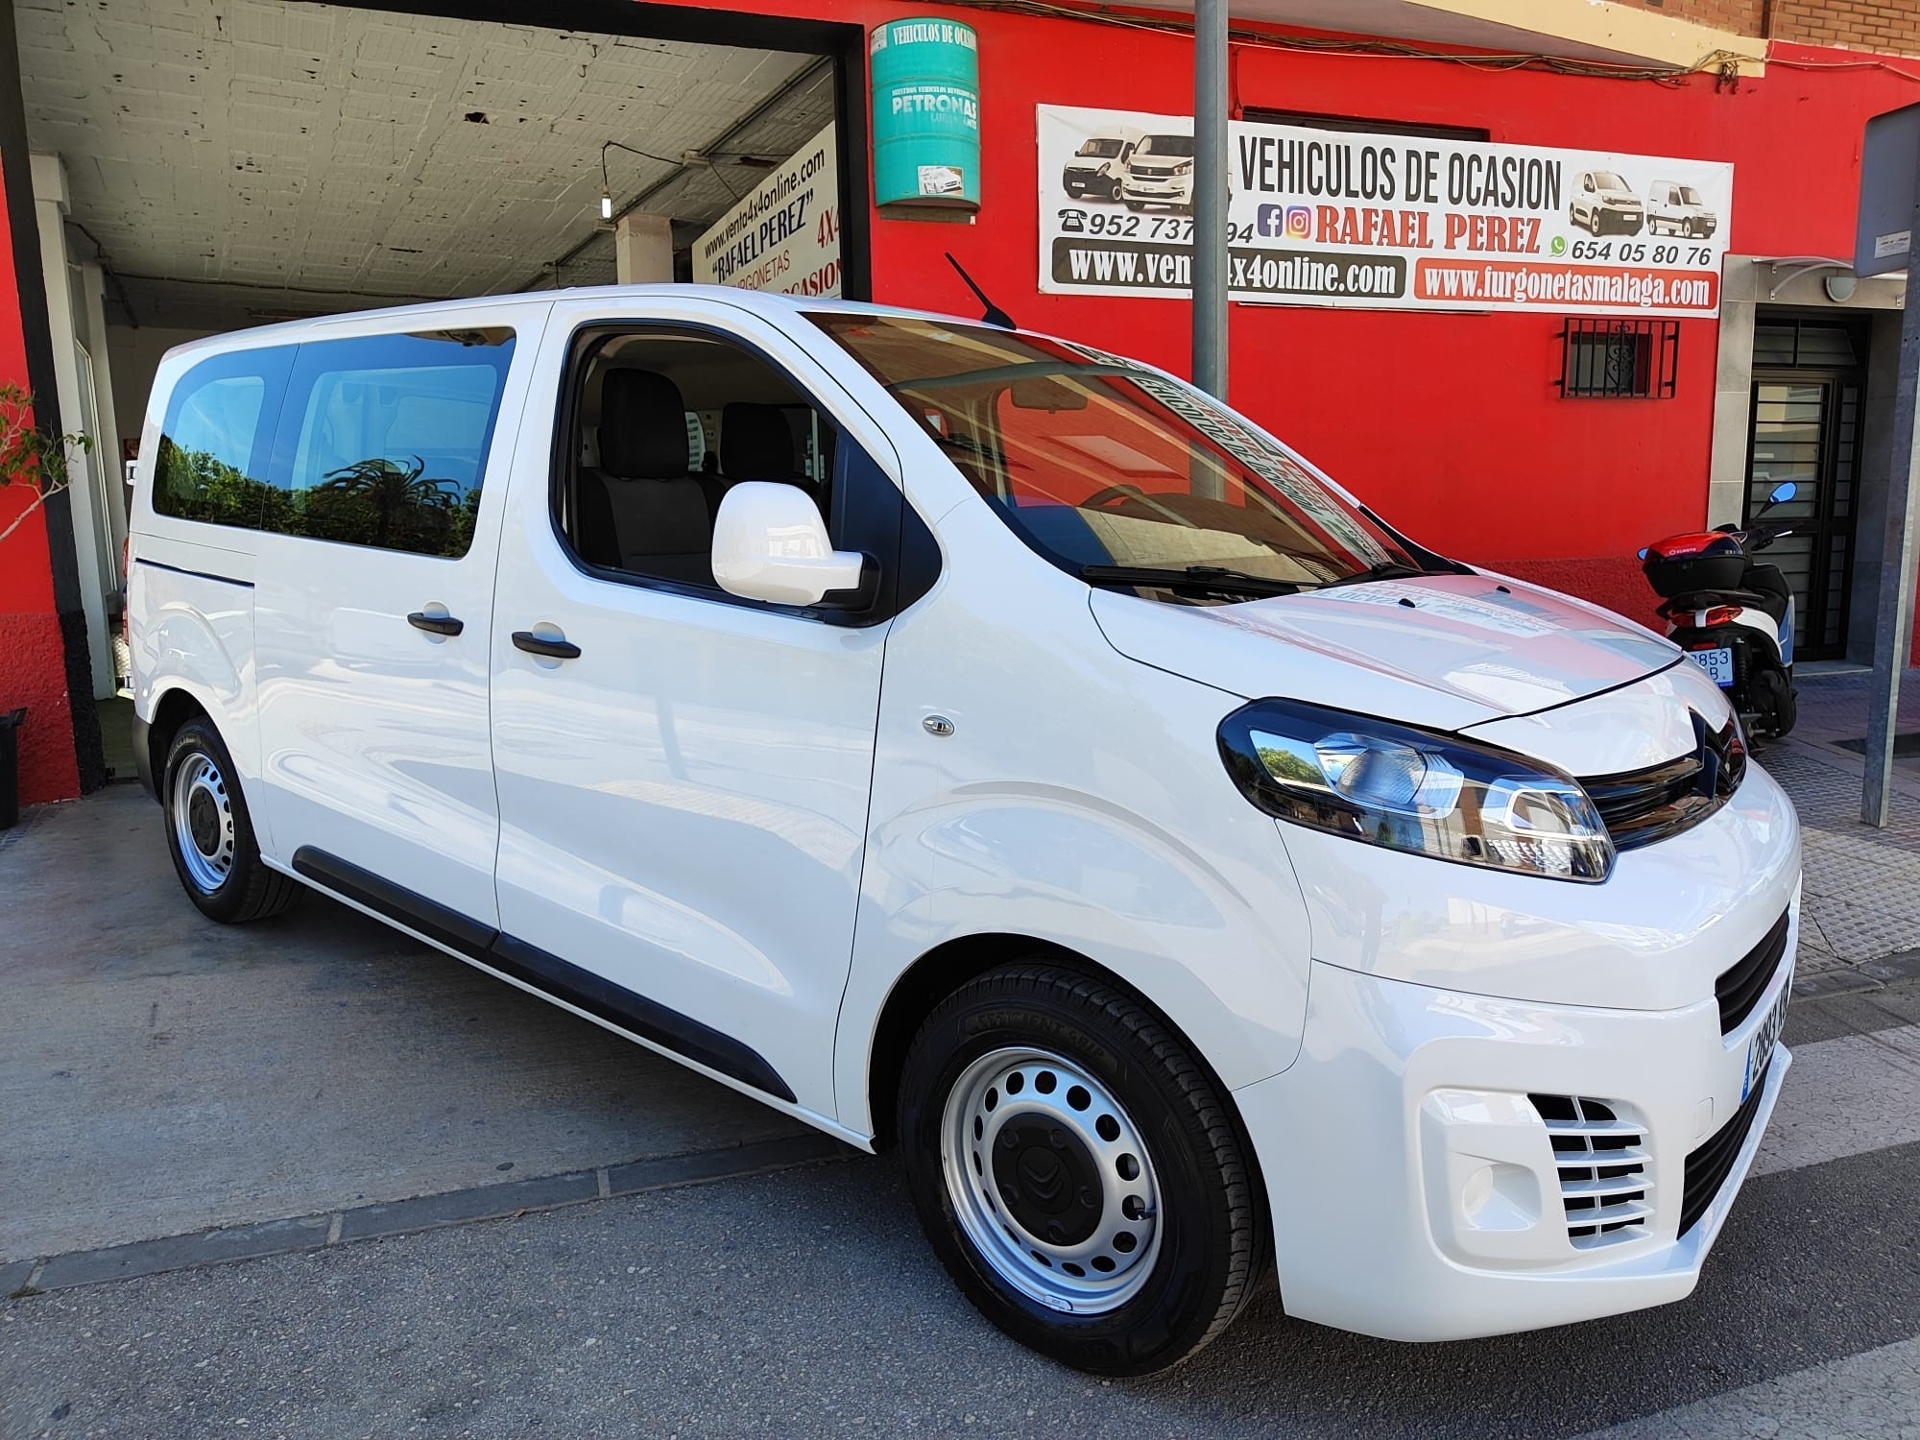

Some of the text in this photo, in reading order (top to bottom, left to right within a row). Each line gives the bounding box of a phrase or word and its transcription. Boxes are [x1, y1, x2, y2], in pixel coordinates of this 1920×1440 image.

[893, 23, 940, 46] VEHICULOS
[941, 25, 955, 44] DE
[892, 94, 977, 120] PETRONAS
[1239, 135, 1562, 211] VEHICULOS DE OCASION
[704, 148, 825, 259] www.venta4x4online.com
[1088, 212, 1142, 237] 952
[1315, 204, 1542, 254] RAFAEL PEREZ
[1068, 248, 1396, 294] www.venx4online.com
[1571, 240, 1712, 266] 654 05 80 76
[1424, 265, 1710, 308] www.furgonetasmalaga.com
